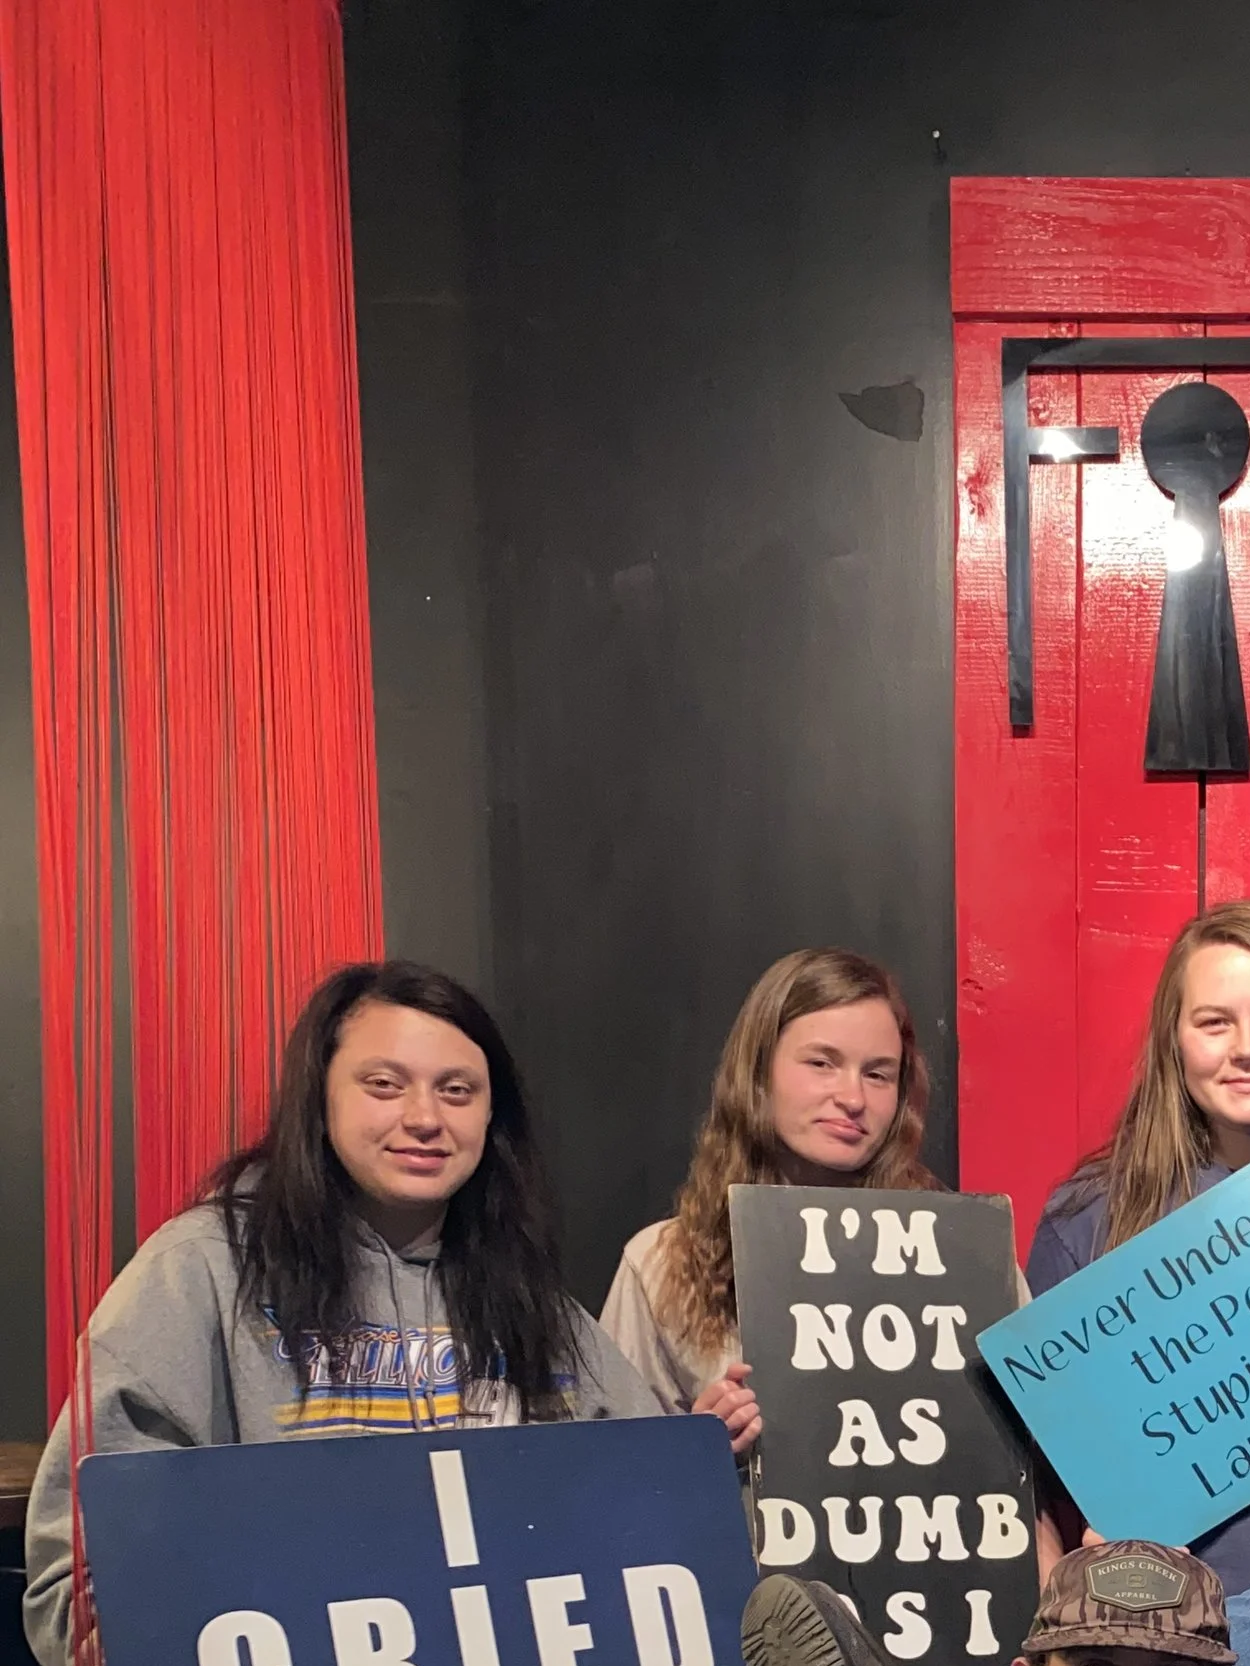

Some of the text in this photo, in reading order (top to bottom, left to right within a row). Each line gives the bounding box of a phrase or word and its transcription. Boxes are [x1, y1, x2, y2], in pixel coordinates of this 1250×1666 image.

[800, 1207, 946, 1276] I'M
[790, 1303, 967, 1371] NOT
[1003, 1286, 1138, 1392] Never
[1130, 1316, 1215, 1386] the
[828, 1398, 947, 1467] AS
[430, 1450, 480, 1568] I
[757, 1493, 1029, 1568] DUMB
[1097, 1561, 1178, 1582] KINGS CREEK
[837, 1589, 1000, 1660] S I
